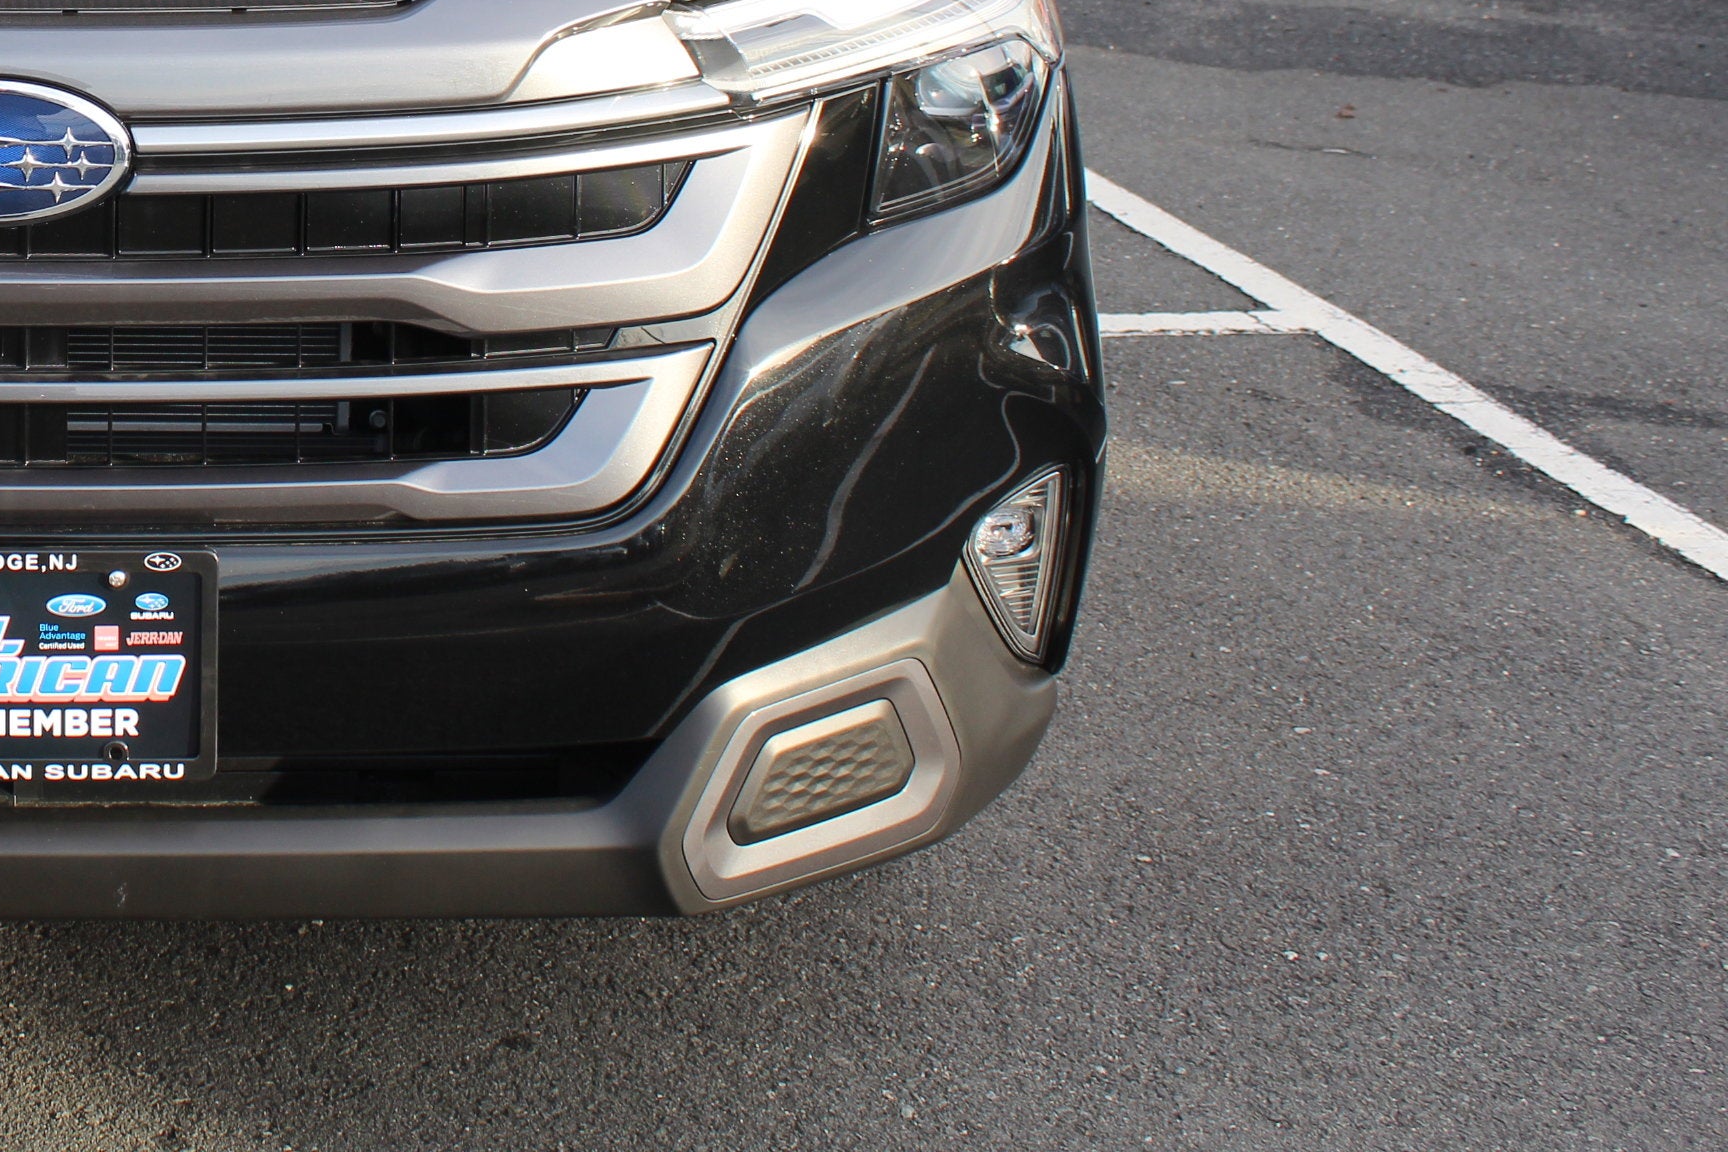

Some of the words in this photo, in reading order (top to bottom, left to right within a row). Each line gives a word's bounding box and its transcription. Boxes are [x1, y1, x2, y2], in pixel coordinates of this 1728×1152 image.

[58, 598, 94, 613] Ford
[130, 612, 174, 620] SUBARU
[39, 623, 59, 632] Blue
[39, 632, 86, 641] Advantage
[38, 642, 66, 650] Certified
[68, 642, 85, 650] Used
[44, 763, 184, 780] SUBARU
